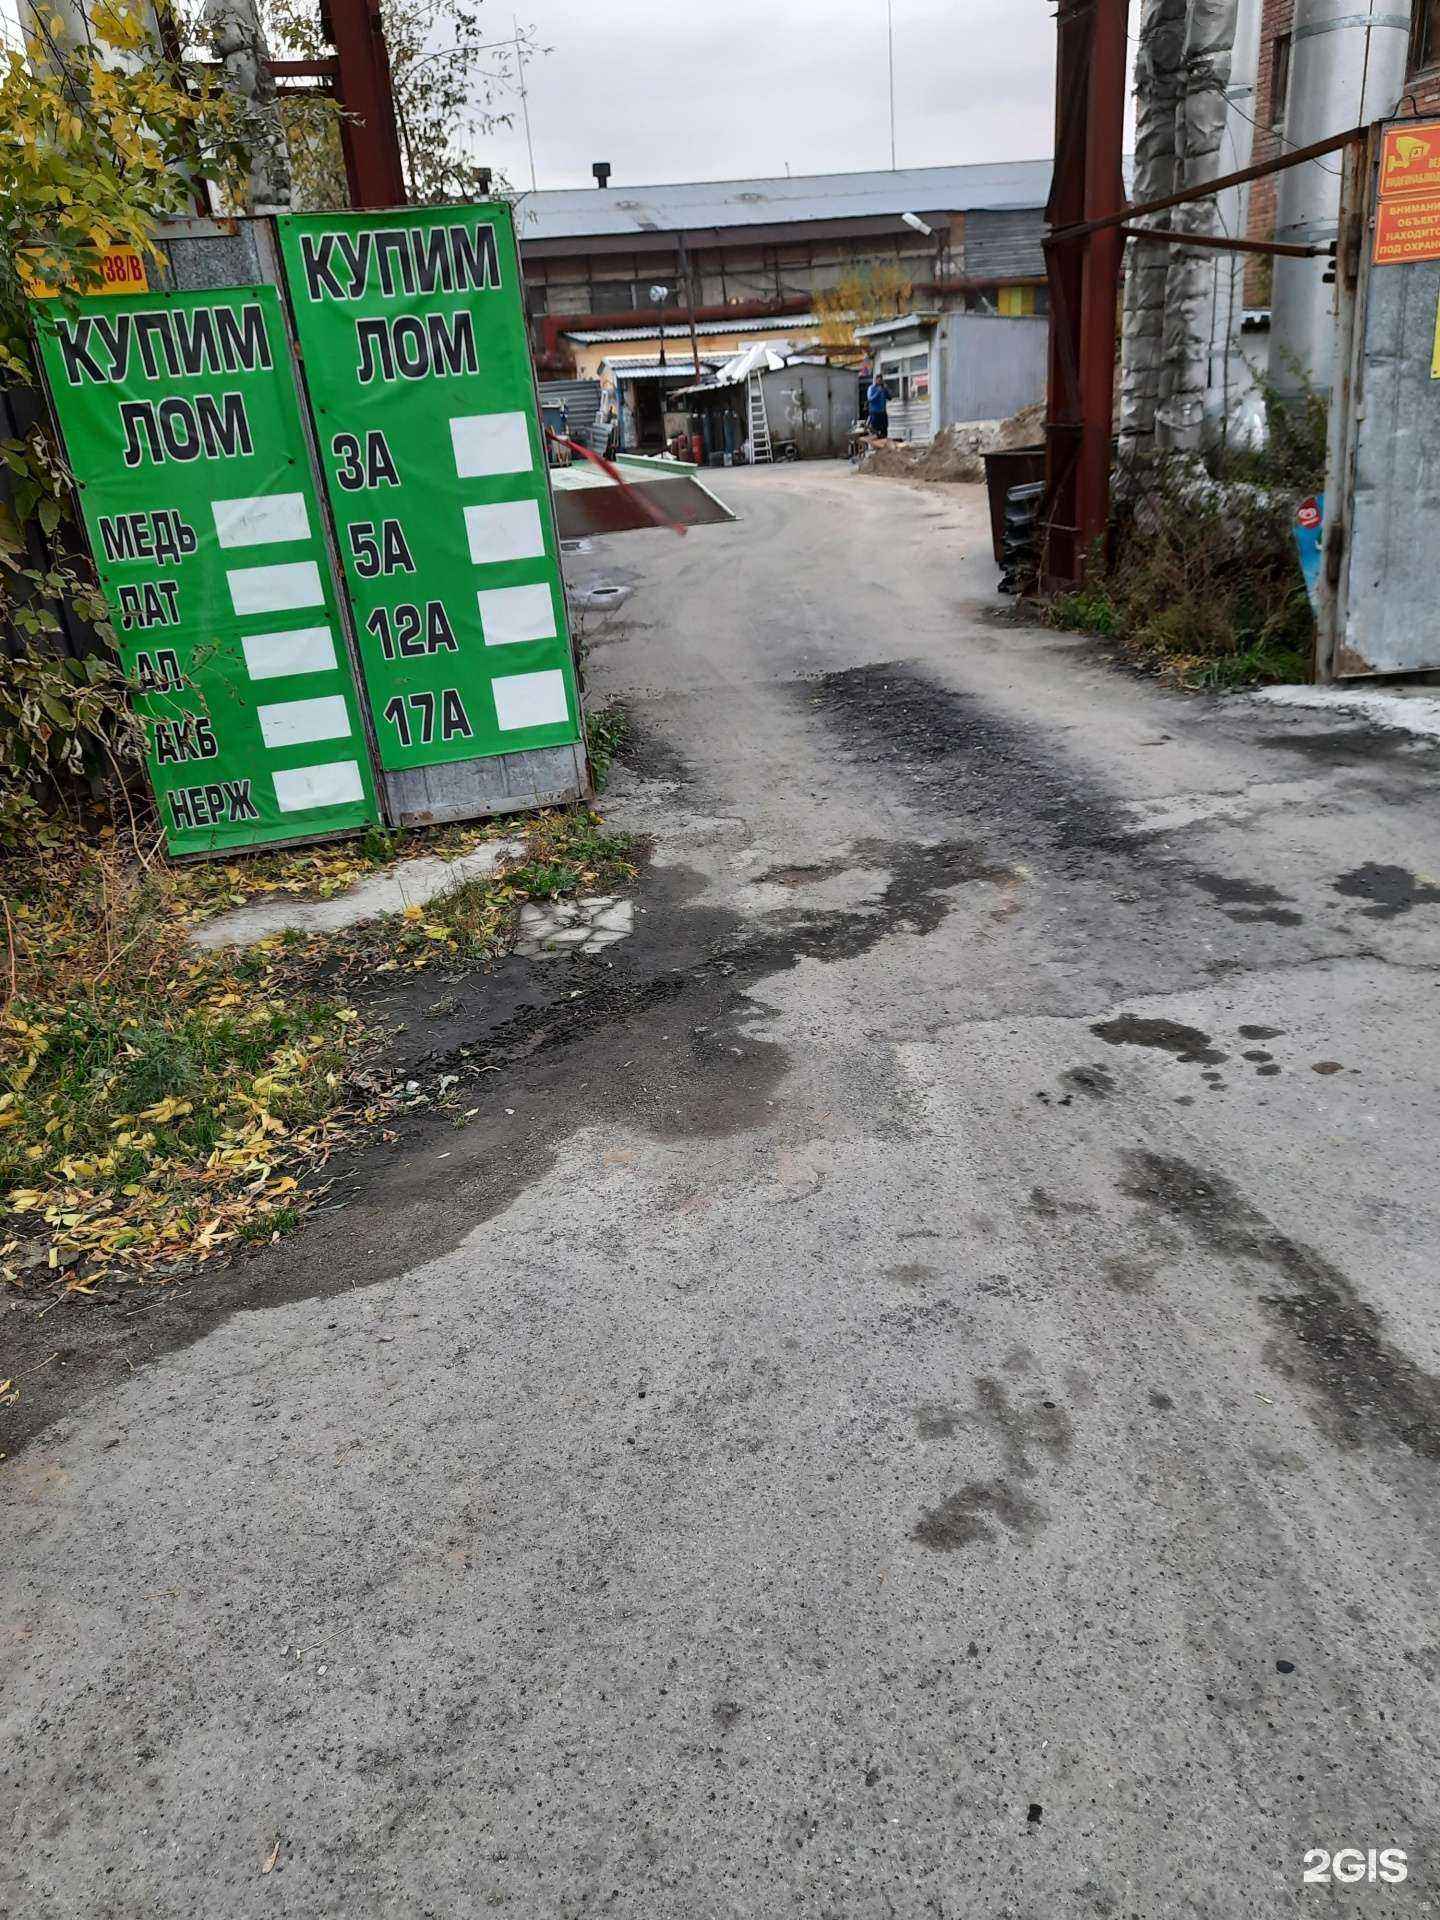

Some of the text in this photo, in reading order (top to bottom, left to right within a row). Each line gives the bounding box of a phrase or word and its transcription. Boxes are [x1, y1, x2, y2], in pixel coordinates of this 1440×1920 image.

[299, 222, 502, 303] КУПИМ
[57, 303, 275, 388] КУПИМ
[354, 309, 482, 386] ЛОМ
[117, 392, 257, 469] ЛОМ
[97, 509, 198, 566] МЕДЬ
[347, 517, 417, 579] 5А
[116, 579, 181, 632] ЛАТ
[366, 601, 459, 661] 12А
[133, 648, 185, 697] АЛ
[153, 715, 219, 766] АКБ
[382, 689, 472, 748] 17А
[166, 778, 260, 832] НЕРЖ
